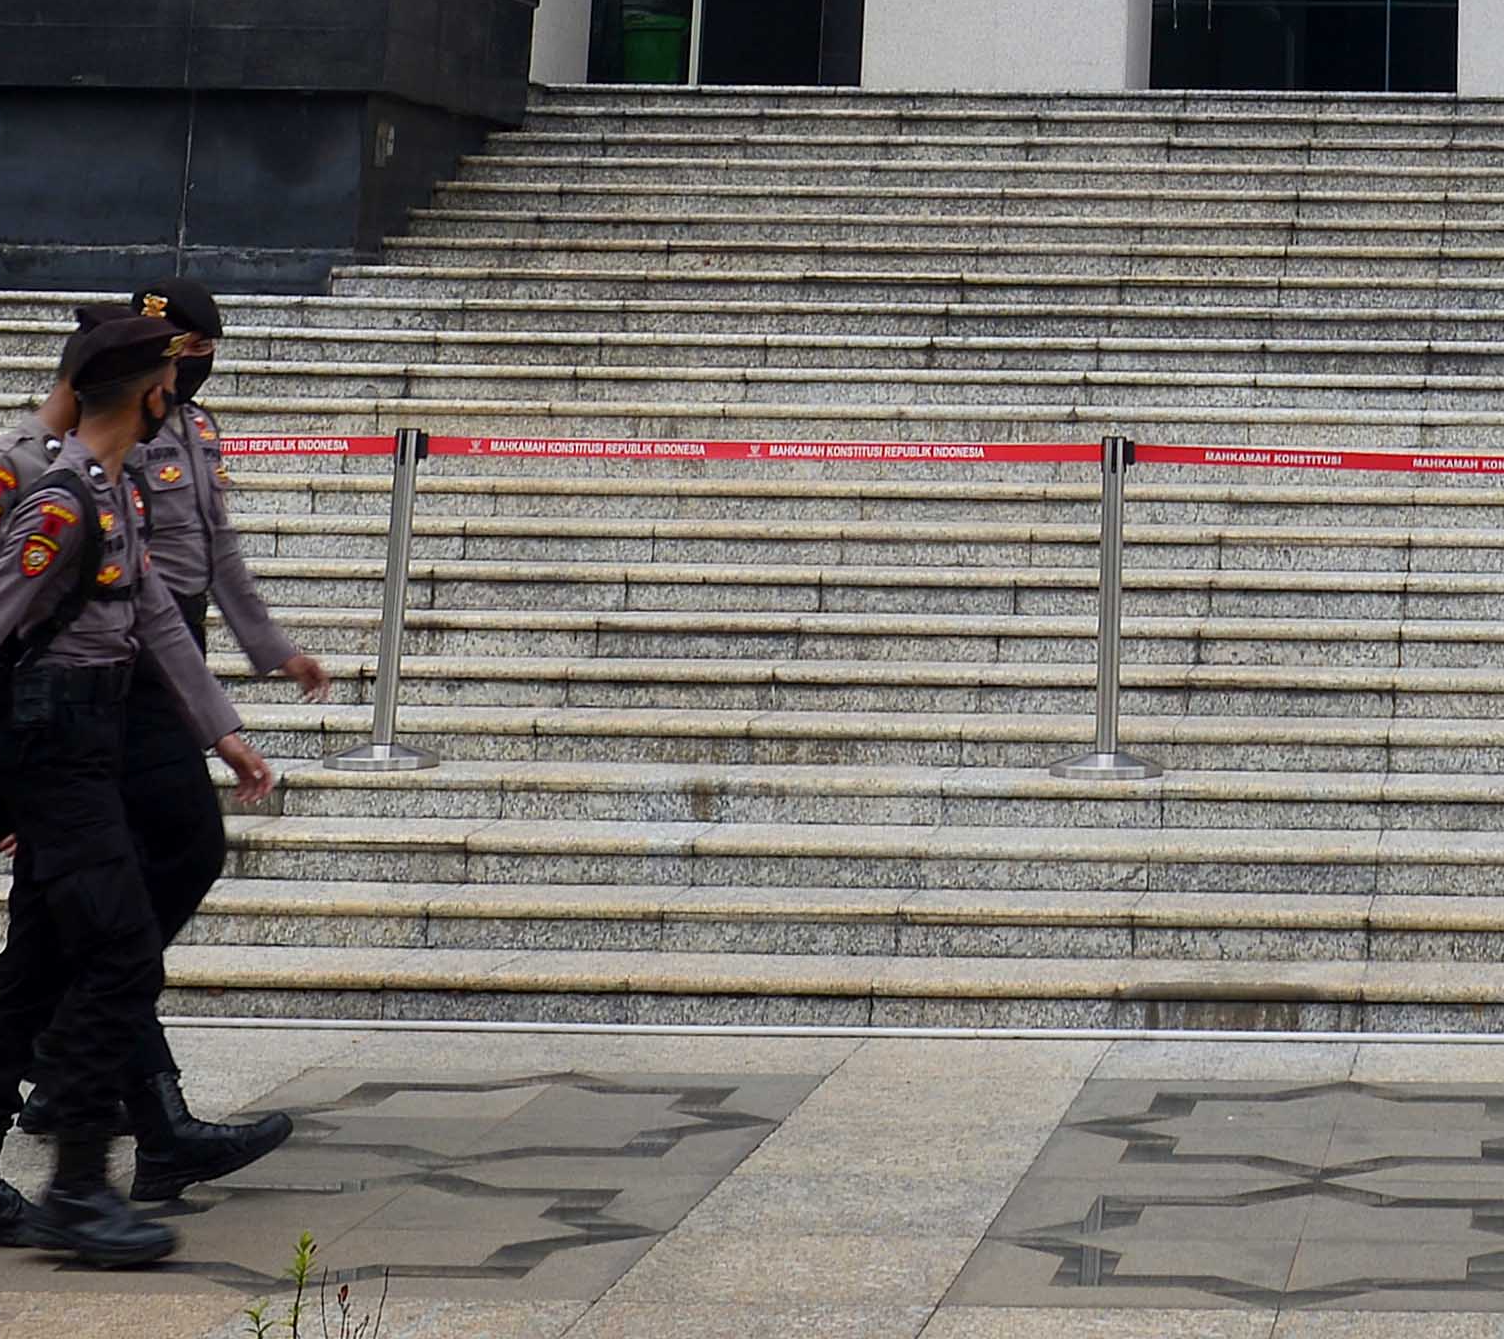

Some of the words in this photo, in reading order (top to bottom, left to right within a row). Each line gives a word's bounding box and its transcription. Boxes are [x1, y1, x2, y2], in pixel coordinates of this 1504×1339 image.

[249, 440, 296, 452] REPUBLIK
[298, 439, 349, 451] INDONESIA
[490, 441, 546, 454] MAHKAMAH
[547, 442, 604, 455] KONSTITUSI
[605, 442, 653, 455] REPUBLIK
[654, 444, 705, 456] INDONESIA
[769, 445, 825, 457] MAHKAMAH
[826, 445, 883, 458] KONSTITUSI
[884, 445, 932, 458] REPUBLIK
[933, 446, 985, 458] INDONESIA
[1205, 451, 1271, 464] MAHKAMAH
[1273, 454, 1342, 466] KONSTITUSI
[1413, 458, 1478, 470] MAHKAMAH
